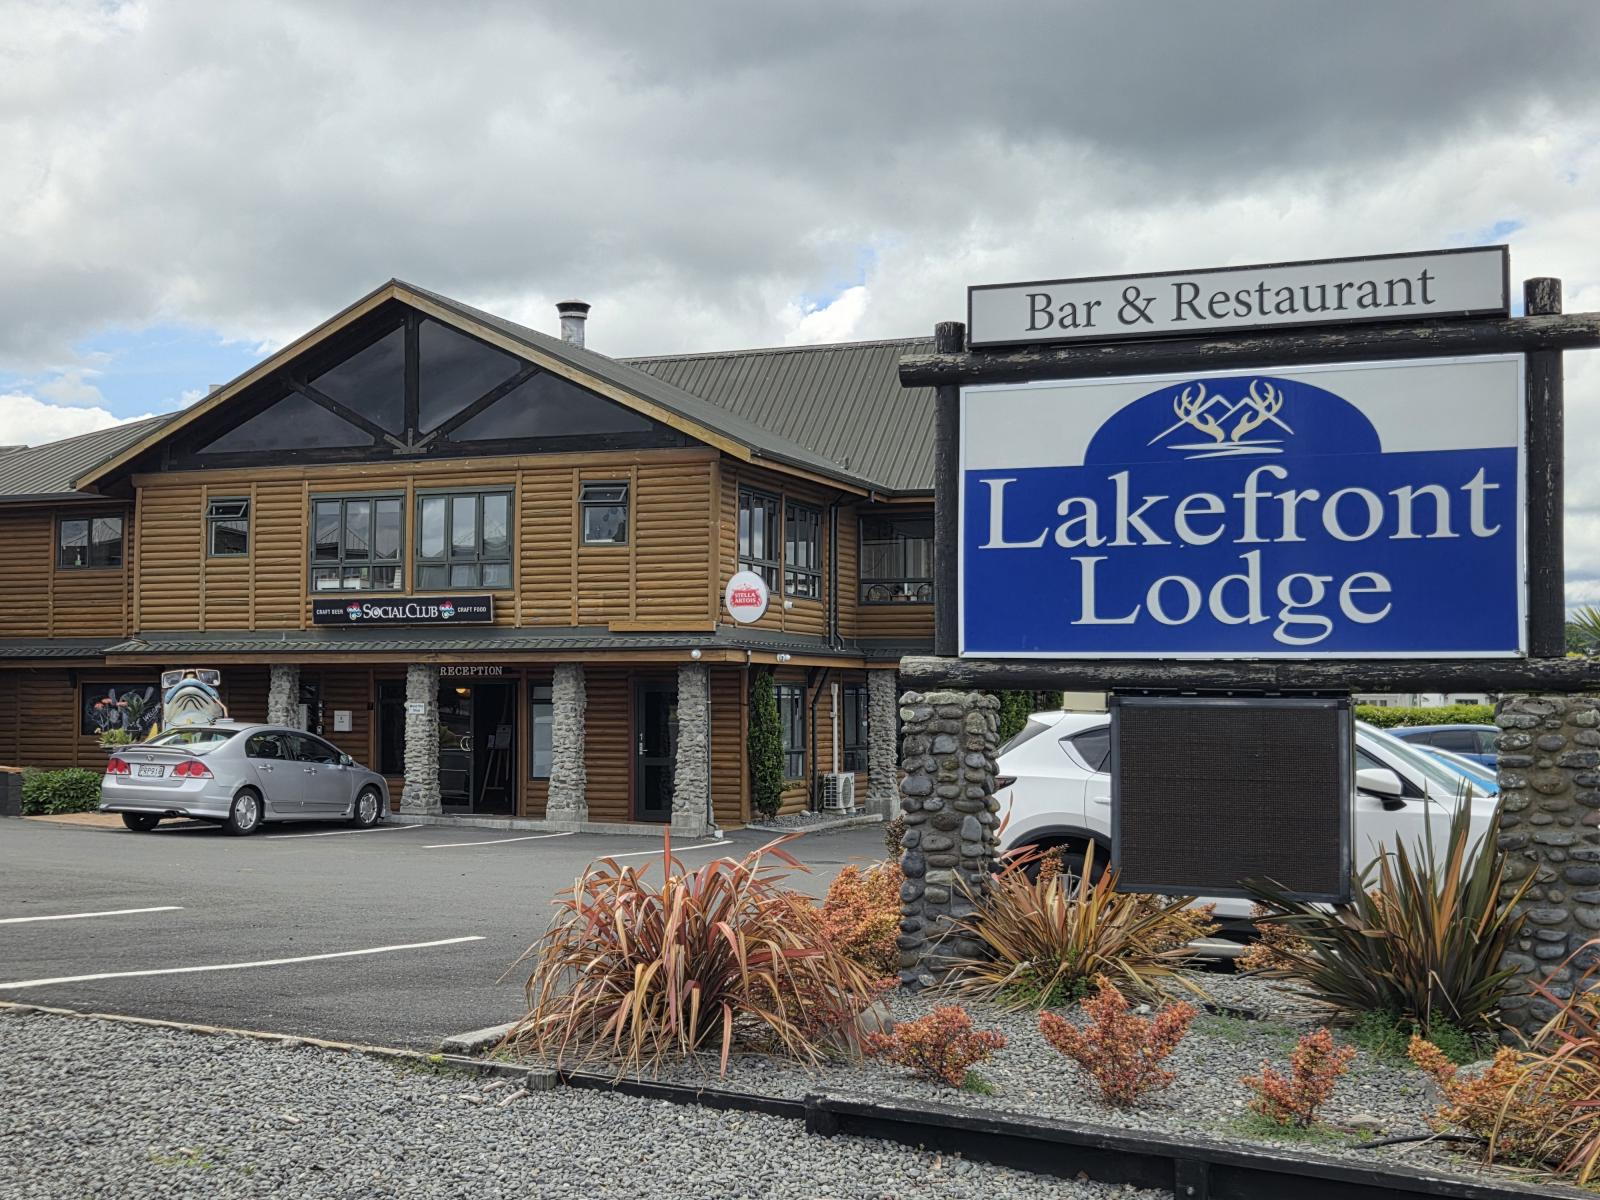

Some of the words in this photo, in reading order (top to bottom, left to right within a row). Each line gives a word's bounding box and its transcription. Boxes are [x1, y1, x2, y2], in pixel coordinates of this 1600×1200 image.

[1024, 292, 1102, 332] Bar
[1116, 285, 1157, 325] &
[1169, 267, 1437, 322] Restaurant
[978, 464, 1501, 550] Lakefront
[1070, 549, 1393, 646] Lodge
[440, 665, 503, 676] RECEPTION
